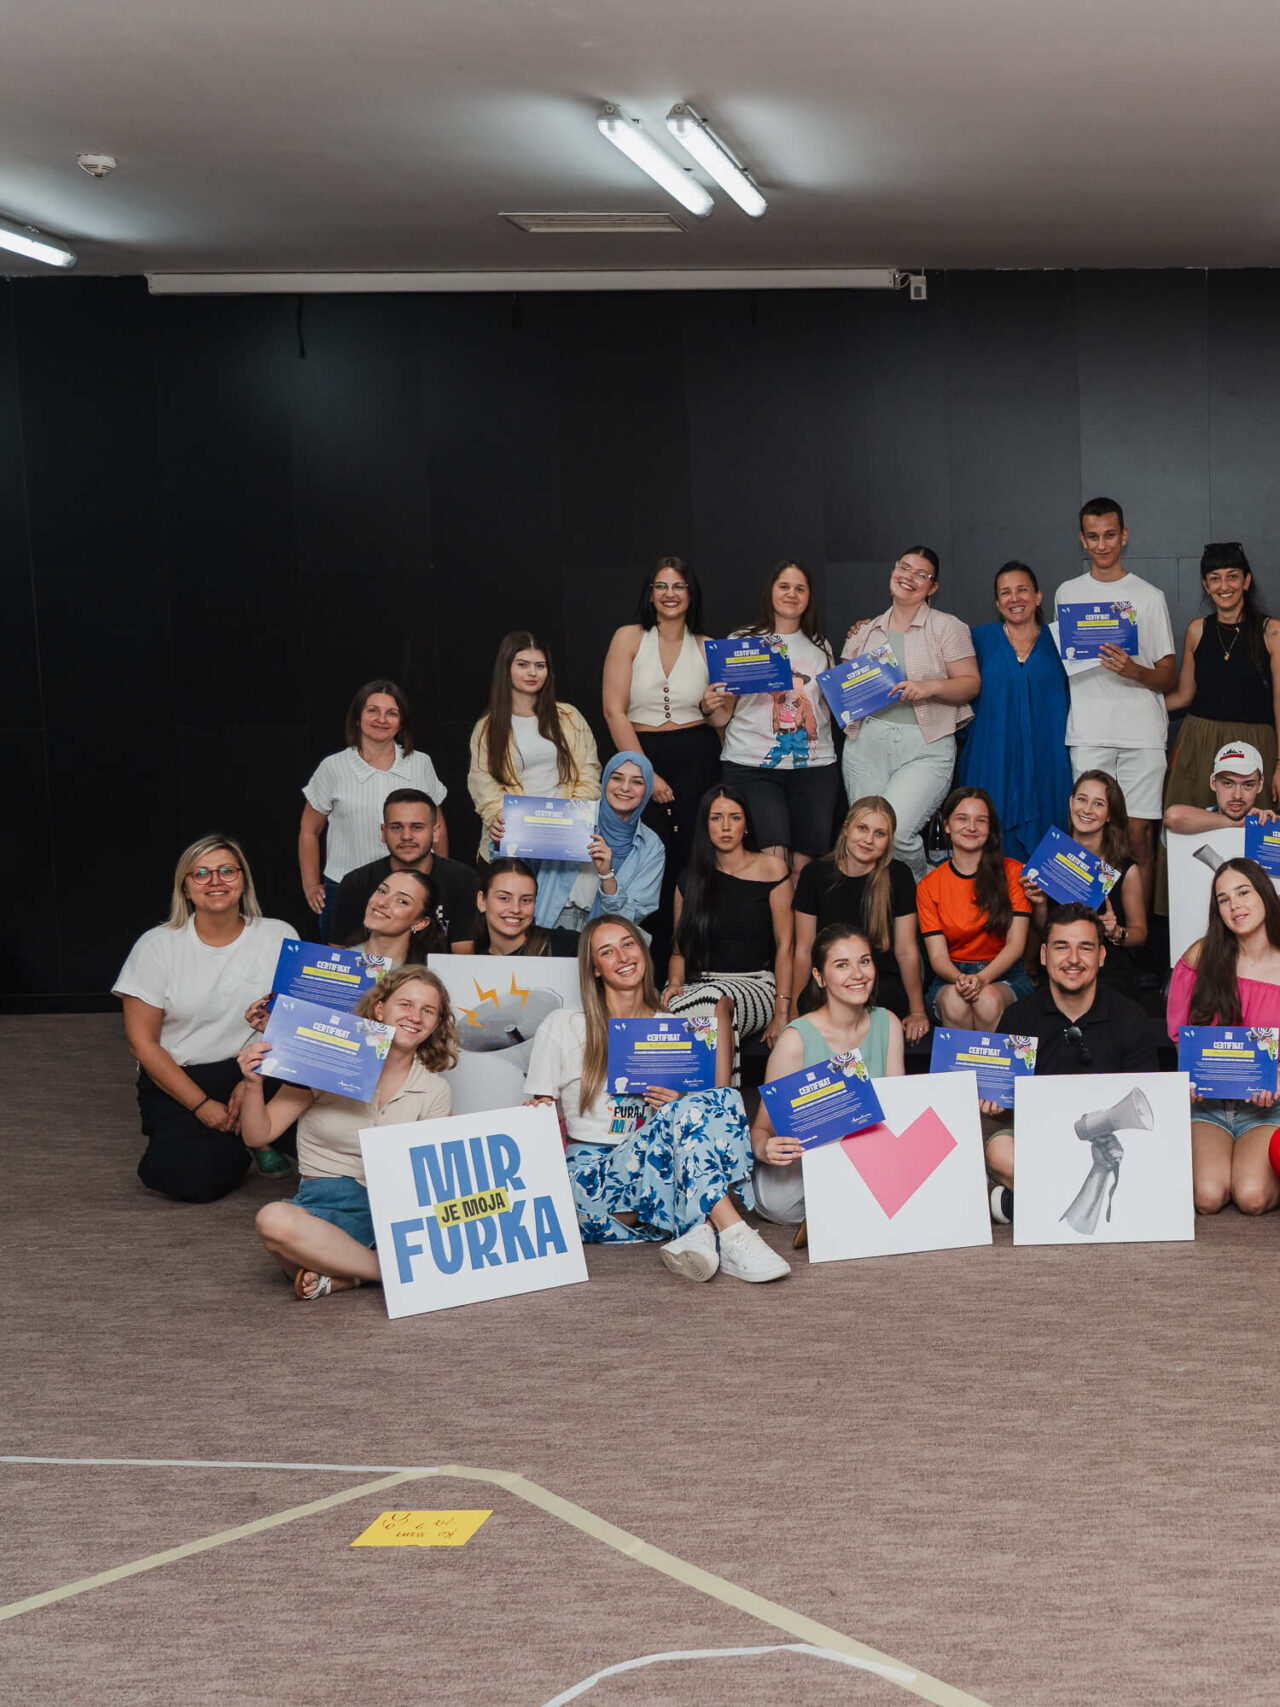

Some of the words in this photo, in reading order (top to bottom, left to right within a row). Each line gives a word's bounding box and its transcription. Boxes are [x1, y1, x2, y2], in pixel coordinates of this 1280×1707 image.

[614, 1104, 649, 1118] FURAJ
[408, 1133, 526, 1207] MIR
[441, 1202, 461, 1223] JE
[462, 1192, 507, 1218] MOJA
[391, 1195, 568, 1284] FURKA
